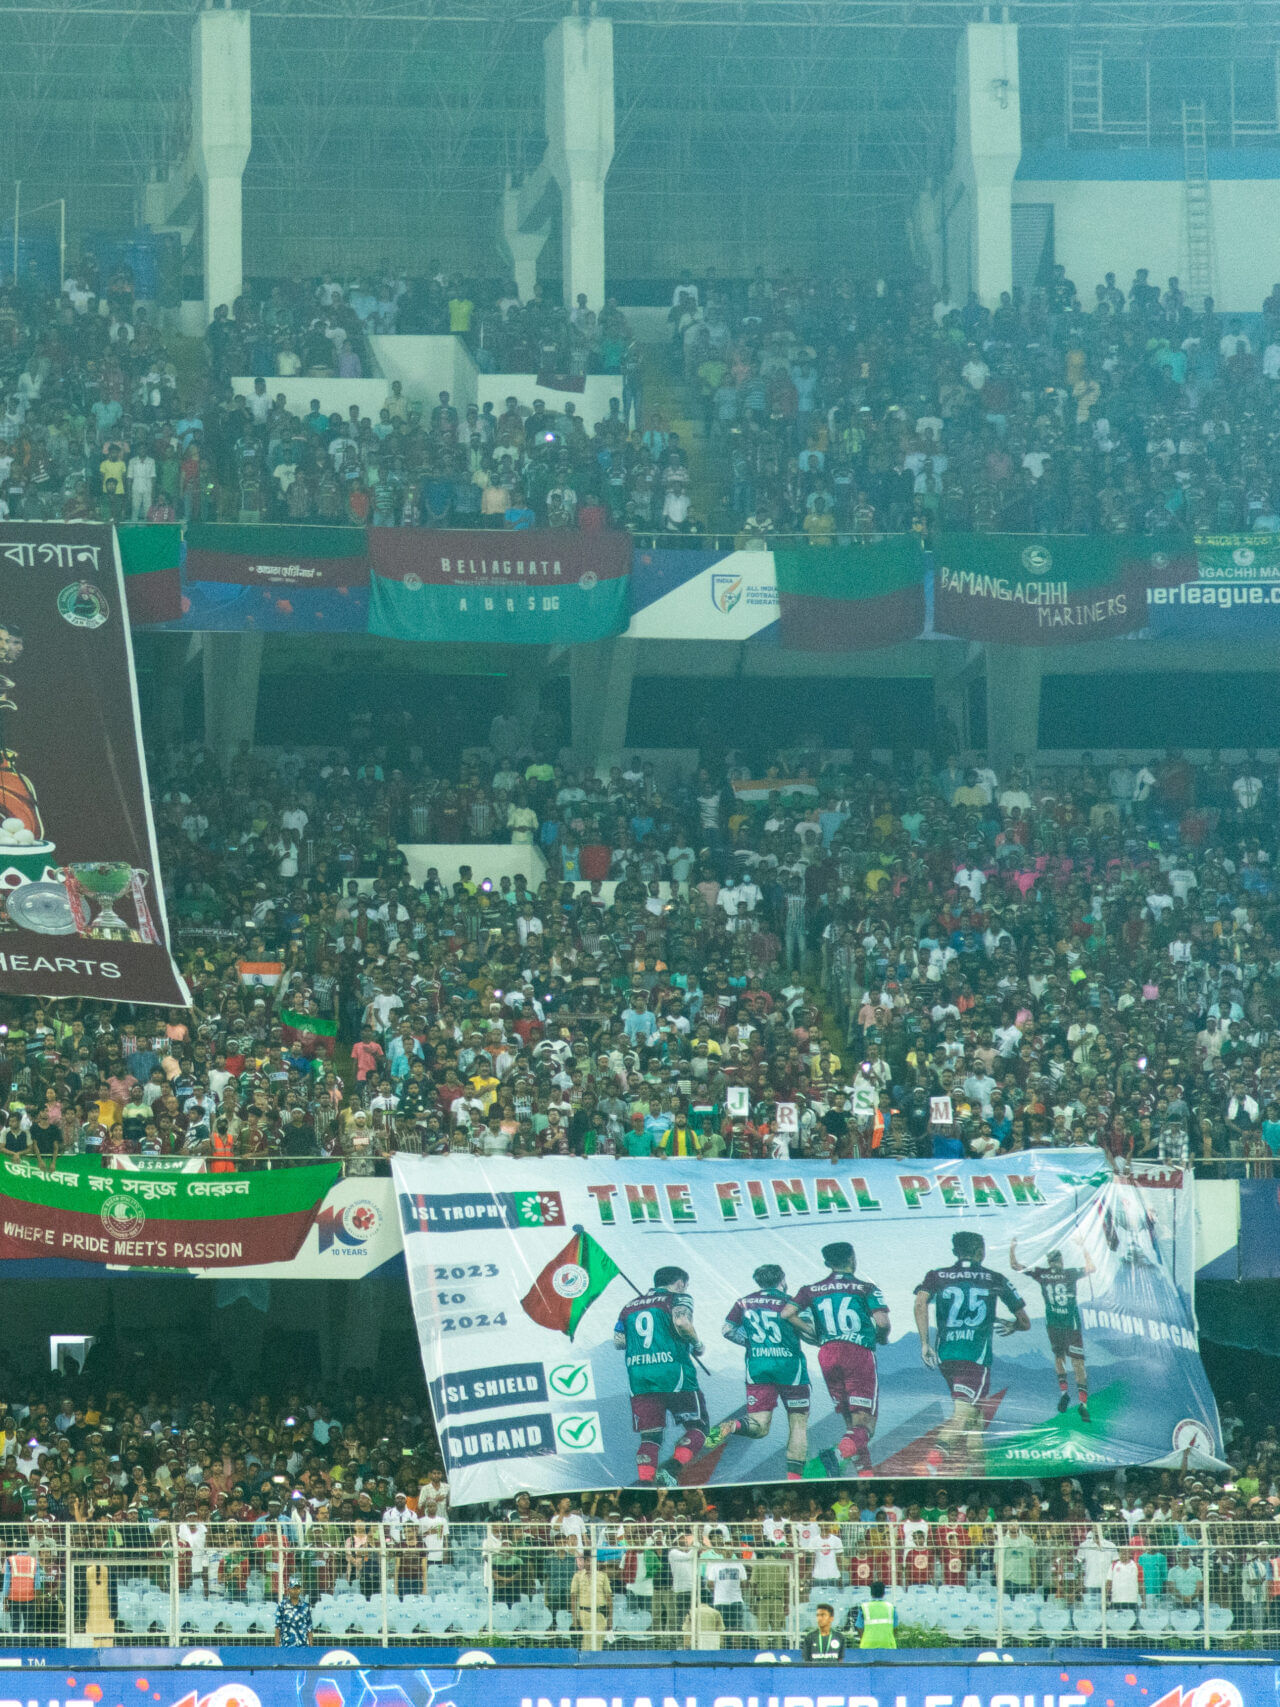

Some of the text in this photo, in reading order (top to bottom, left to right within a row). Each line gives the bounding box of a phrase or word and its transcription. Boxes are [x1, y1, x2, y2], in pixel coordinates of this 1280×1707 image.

[441, 558, 562, 576] BELIAGHATA
[941, 566, 1068, 605] BAMANGACHHI
[1038, 594, 1127, 627] MARINERS
[88, 1175, 115, 1195] রং
[121, 1178, 178, 1200] সবুজ
[187, 1181, 251, 1198] মেরুন
[587, 1173, 1048, 1226] THE FINAL PEAK
[411, 1204, 508, 1221] ISL TROPHY
[4, 1221, 55, 1245] WHERE
[62, 1233, 110, 1254] PRIDE
[174, 1242, 243, 1259] PASSION
[434, 1263, 500, 1280] 2023
[938, 1271, 992, 1280] GIGABYTE
[437, 1291, 466, 1305] to
[810, 1282, 865, 1292] GIGABYTE
[1046, 1283, 1069, 1306] 18
[441, 1311, 508, 1331] 2024
[817, 1296, 862, 1336] 16
[942, 1286, 989, 1327] 25
[635, 1310, 655, 1349] 9
[744, 1309, 782, 1344] 35
[441, 1375, 539, 1404] ISL SHIELD
[448, 1426, 543, 1458] DURAND
